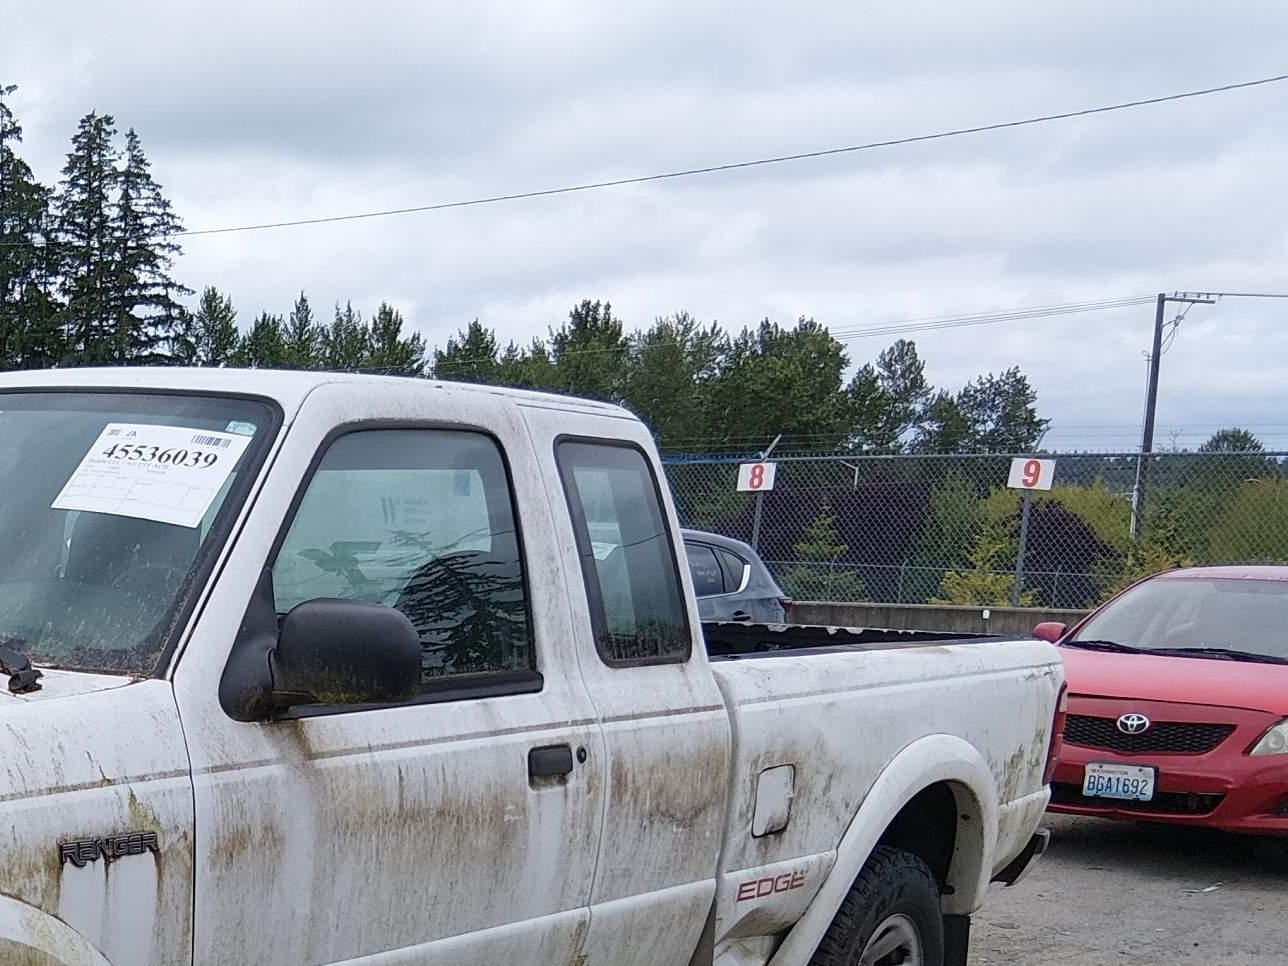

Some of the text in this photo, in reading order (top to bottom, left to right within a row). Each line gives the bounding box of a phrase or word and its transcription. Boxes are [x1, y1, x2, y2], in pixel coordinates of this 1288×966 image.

[101, 443, 218, 470] 45536039
[748, 464, 765, 490] 8
[1021, 459, 1041, 488] 9
[1087, 775, 1149, 796] BGA1692
[60, 832, 159, 868] RANGER
[736, 871, 807, 902] EDGE
